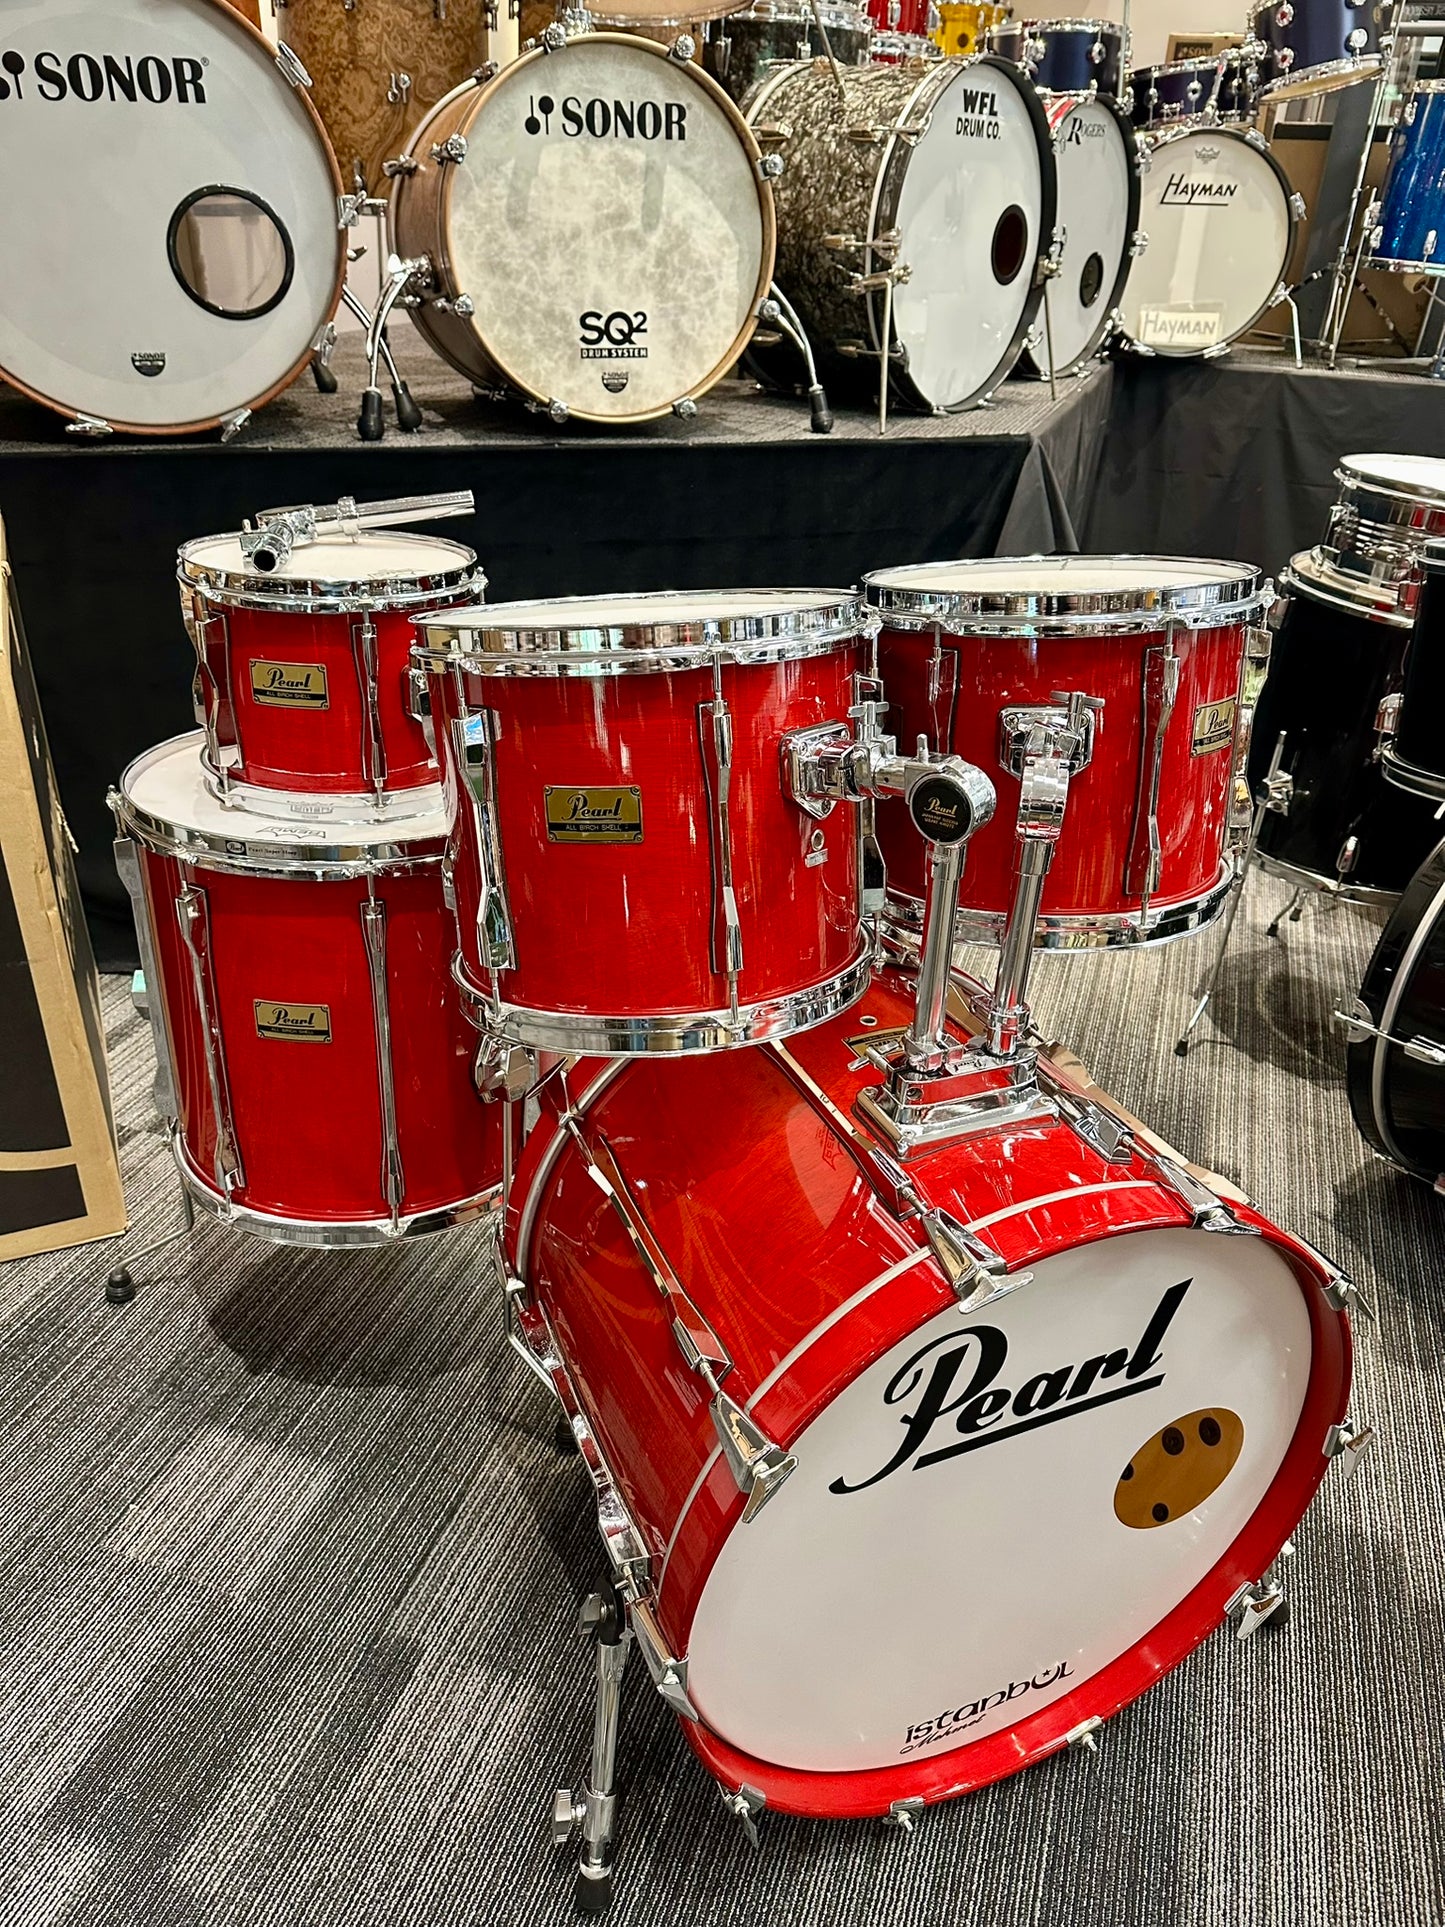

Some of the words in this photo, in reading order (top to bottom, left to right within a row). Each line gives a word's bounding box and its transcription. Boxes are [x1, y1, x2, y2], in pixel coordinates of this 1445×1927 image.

[963, 88, 999, 117] WFL
[561, 96, 687, 141] SONOR
[955, 117, 984, 138] DRUM
[986, 121, 1001, 140] CO.
[582, 349, 609, 358] DRUM
[611, 348, 647, 358] SYSTEM
[262, 667, 311, 689] Pearl
[1202, 707, 1231, 736] Pearl
[561, 793, 623, 821] Pearl
[923, 796, 958, 816] Pearl
[267, 1007, 315, 1026] Pearl
[828, 1277, 1194, 1495] Pearl
